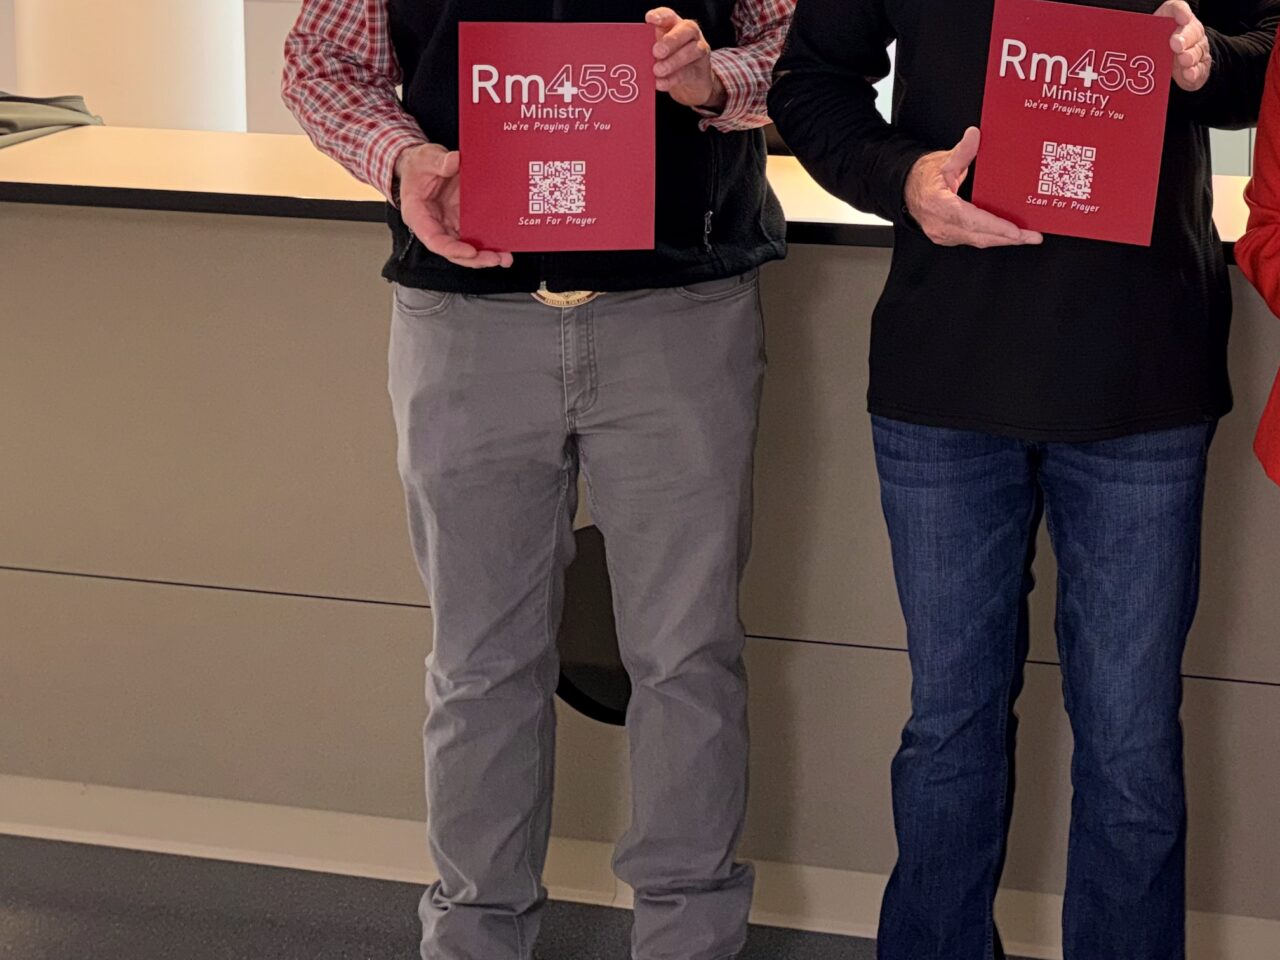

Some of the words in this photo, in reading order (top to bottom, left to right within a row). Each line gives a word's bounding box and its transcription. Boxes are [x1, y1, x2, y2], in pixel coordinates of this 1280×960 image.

[999, 38, 1155, 95] Rm453
[472, 64, 639, 104] Rm453
[1042, 83, 1109, 109] Ministry
[520, 104, 592, 121] Ministry
[1024, 99, 1049, 110] We're
[1052, 102, 1086, 117] Praying
[1090, 107, 1104, 117] for
[1108, 110, 1124, 120] You
[503, 122, 529, 131] We're
[533, 122, 570, 133] Praying
[574, 122, 589, 131] for
[593, 122, 611, 131] You
[1026, 195, 1048, 206] Scan
[1052, 199, 1067, 208] For
[1071, 201, 1100, 214] Prayer
[518, 216, 541, 225] Scan
[546, 216, 561, 225] For
[566, 216, 597, 227] Prayer
